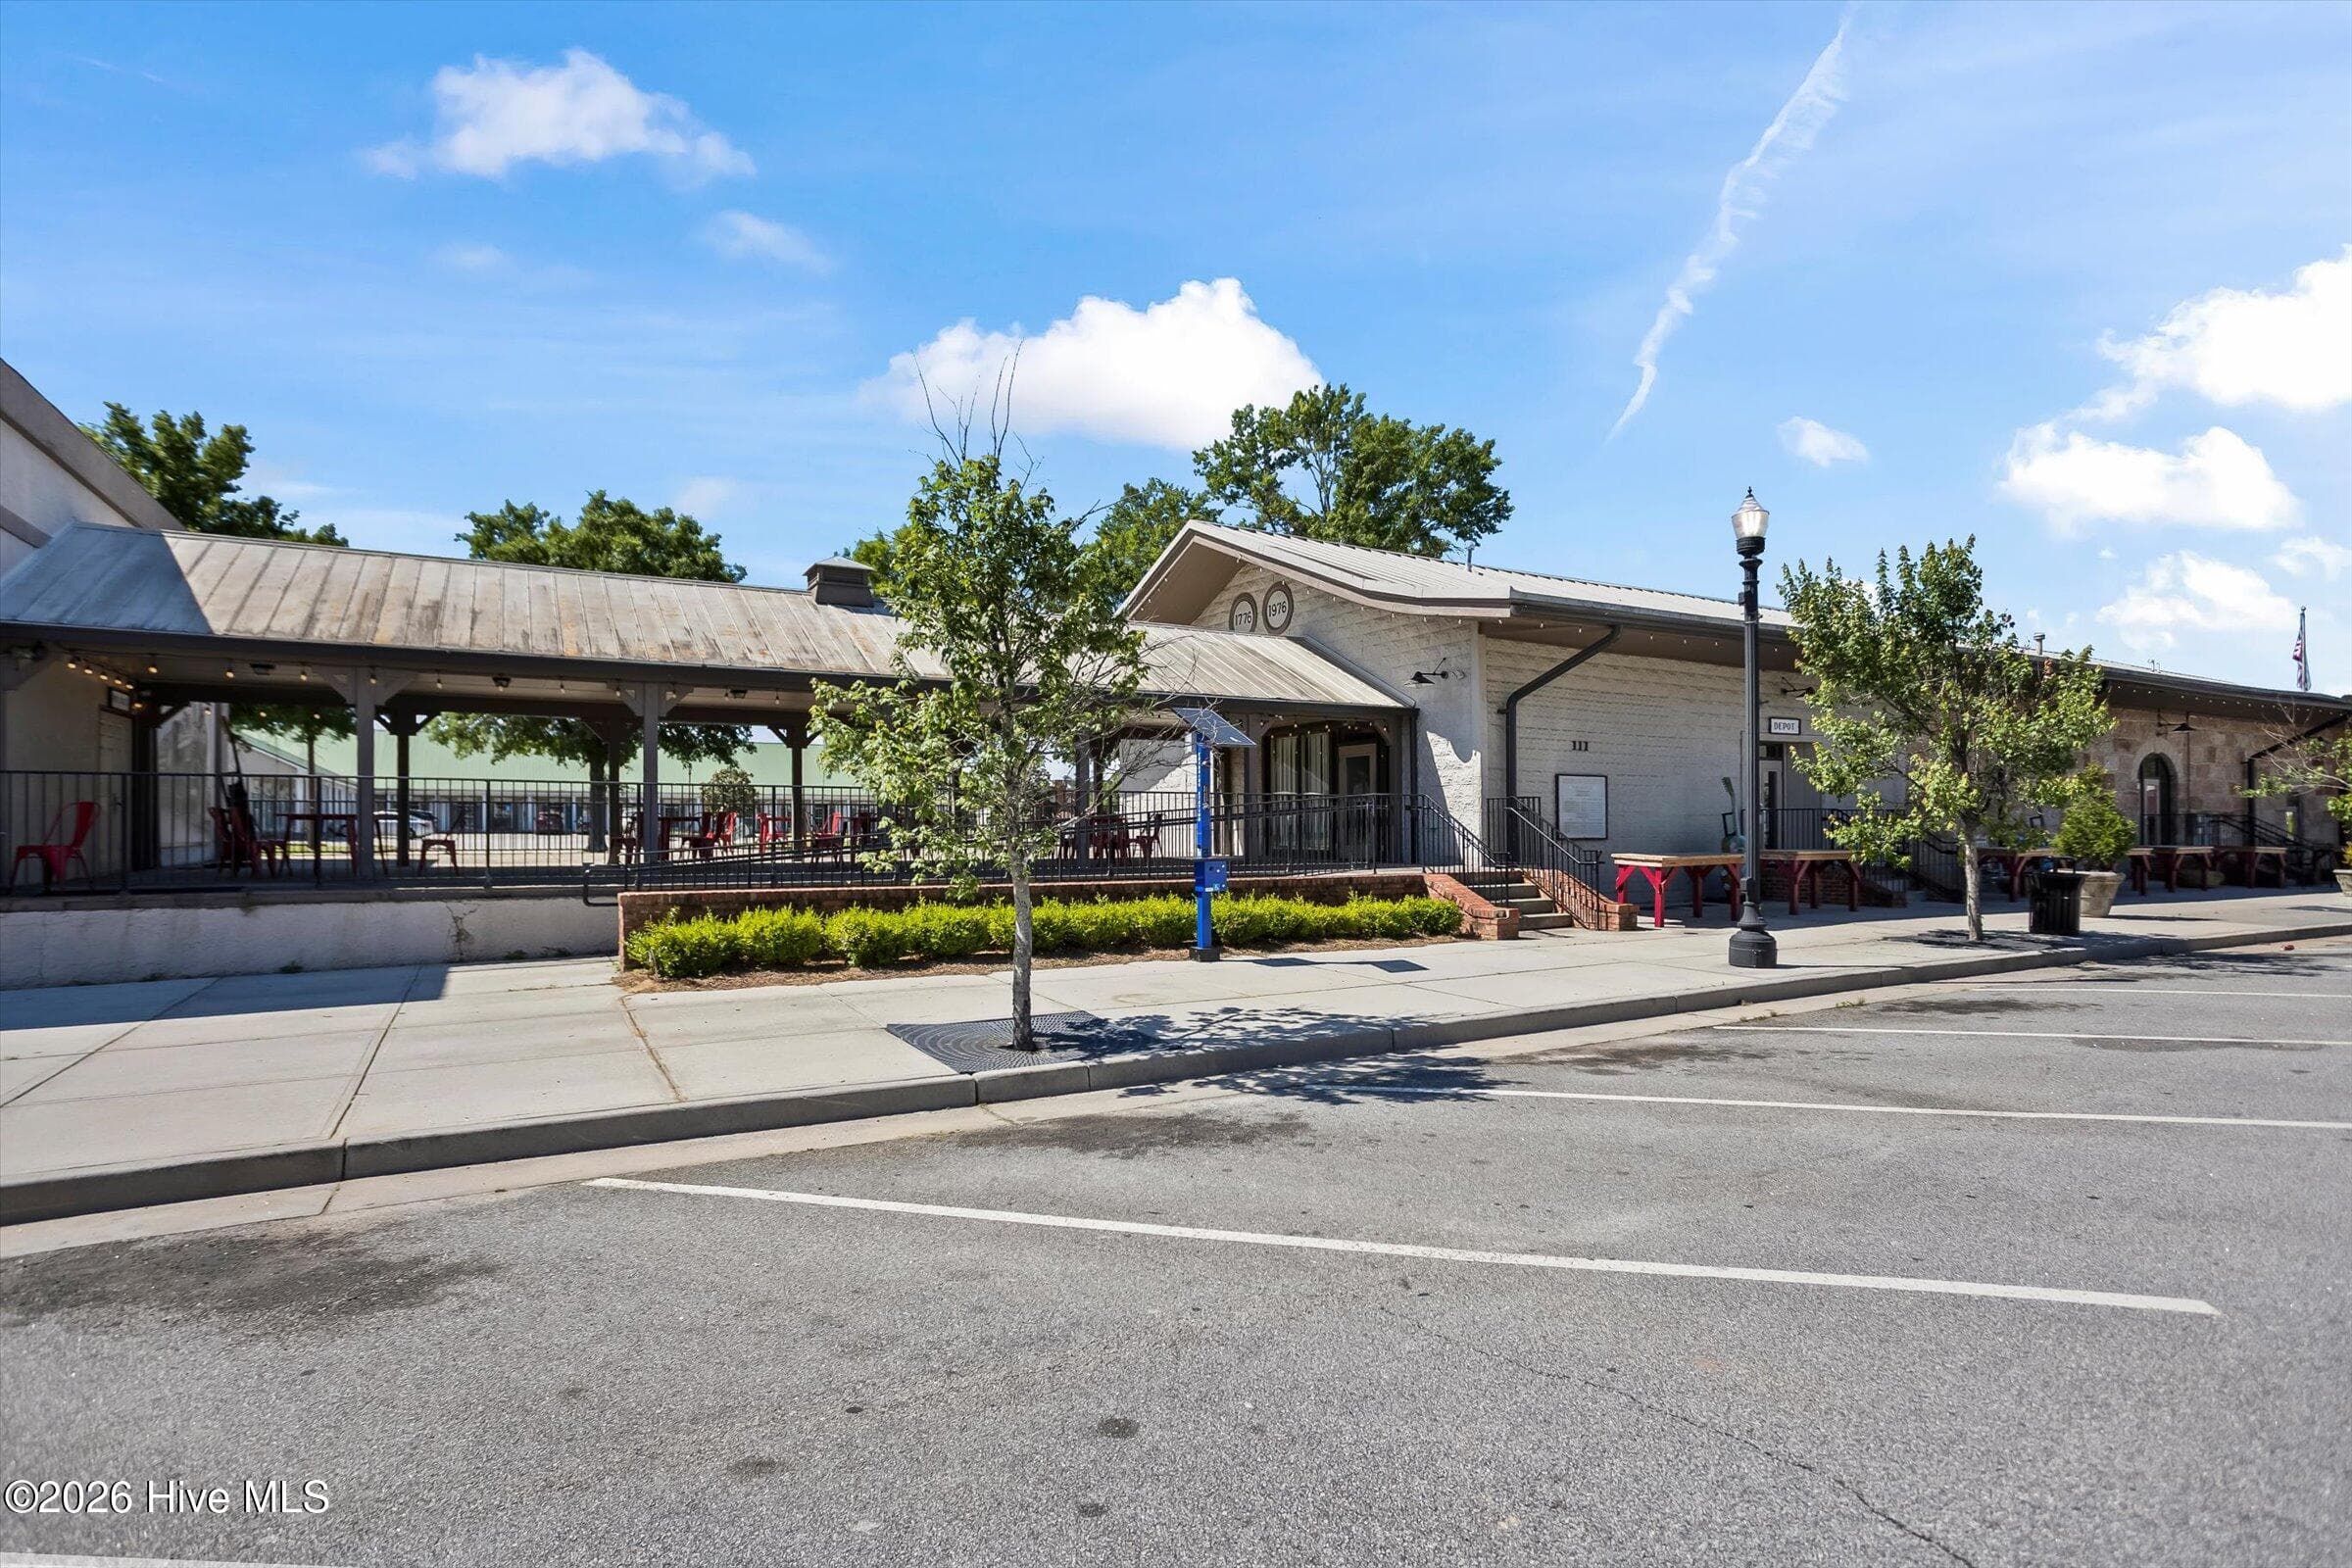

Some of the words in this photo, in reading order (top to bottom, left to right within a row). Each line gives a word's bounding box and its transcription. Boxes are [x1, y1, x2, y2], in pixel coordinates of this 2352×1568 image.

[1269, 601, 1287, 617] 1976
[1235, 612, 1251, 625] 1776
[1774, 721, 1795, 730] DEPOT
